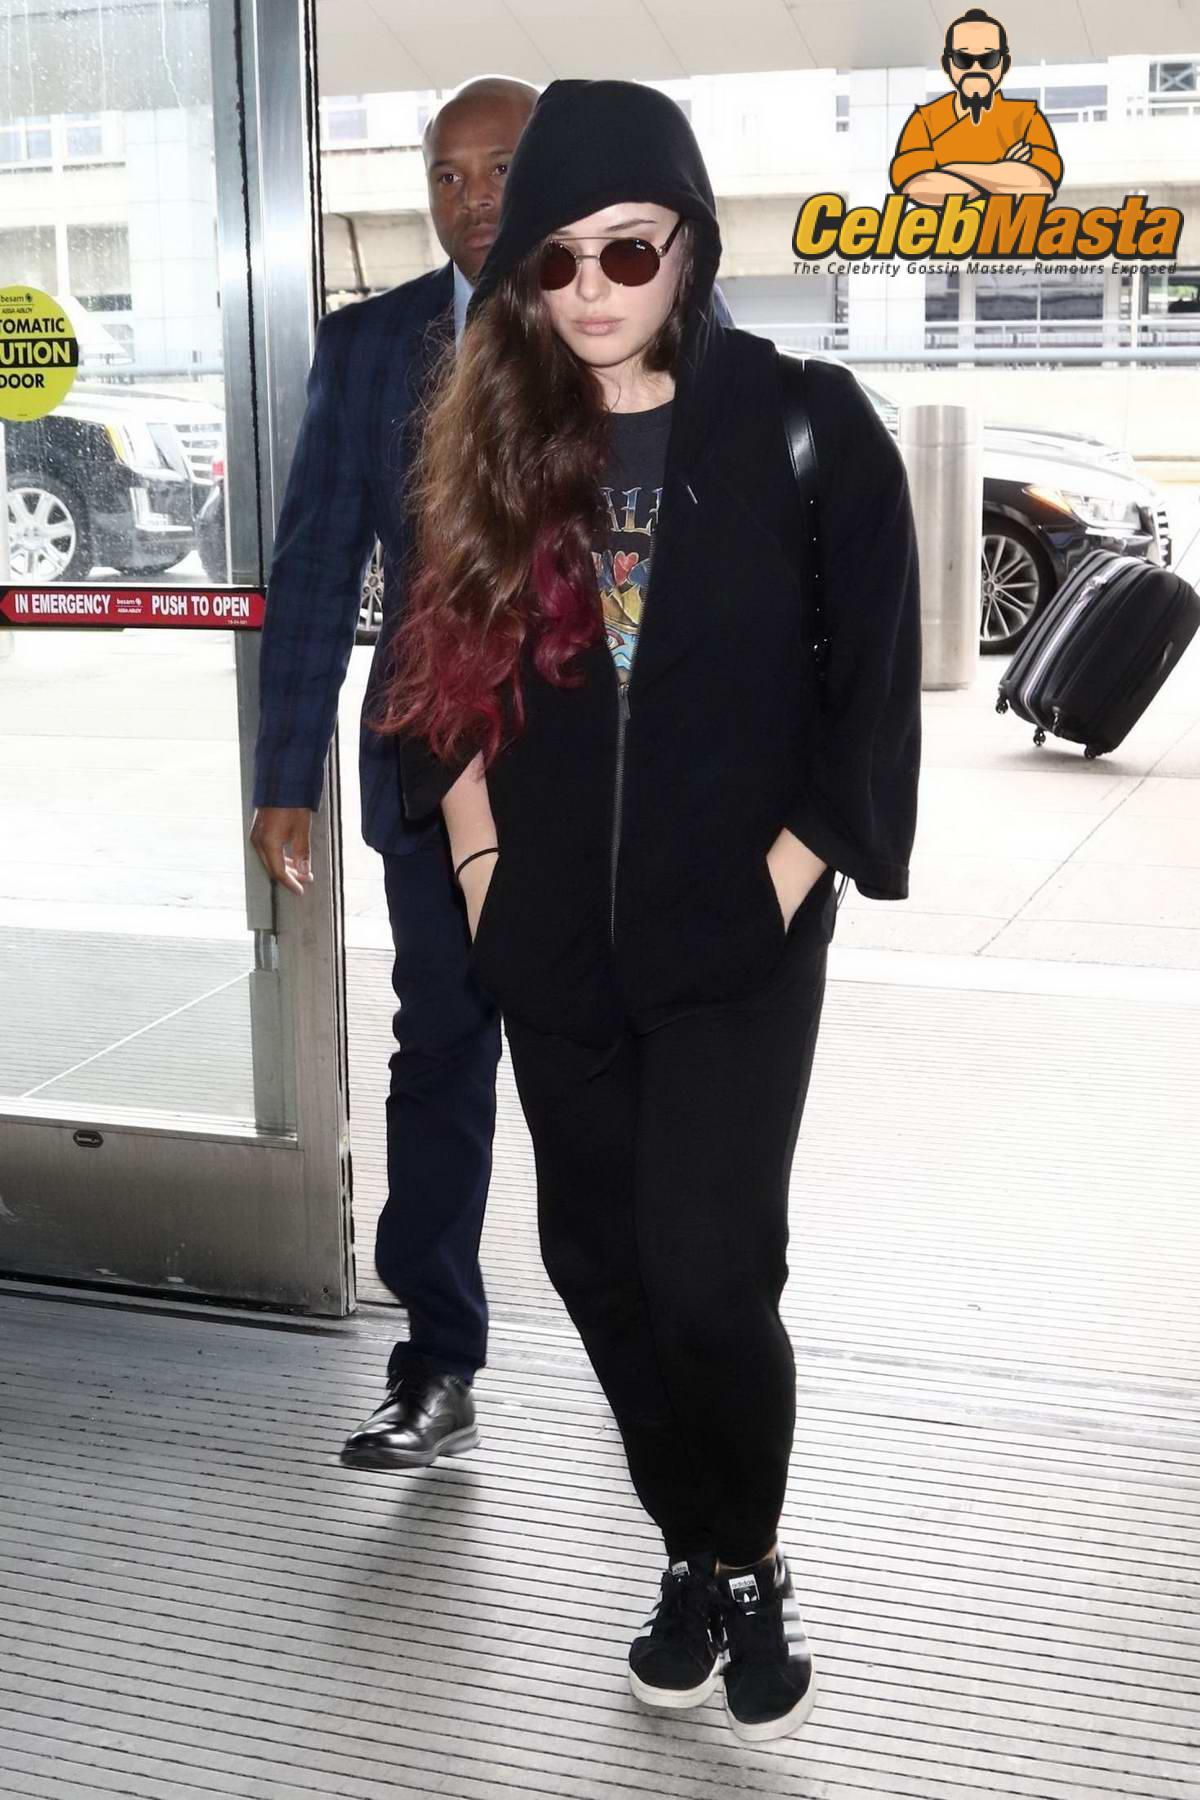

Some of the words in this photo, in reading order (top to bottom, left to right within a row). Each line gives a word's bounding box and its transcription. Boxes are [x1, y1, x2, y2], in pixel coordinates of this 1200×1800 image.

[0, 318, 65, 334] OMATIC
[15, 593, 29, 614] IN
[31, 593, 111, 614] EMERGENCY
[151, 595, 188, 616] PUSH
[191, 596, 209, 616] TO
[212, 596, 250, 617] OPEN
